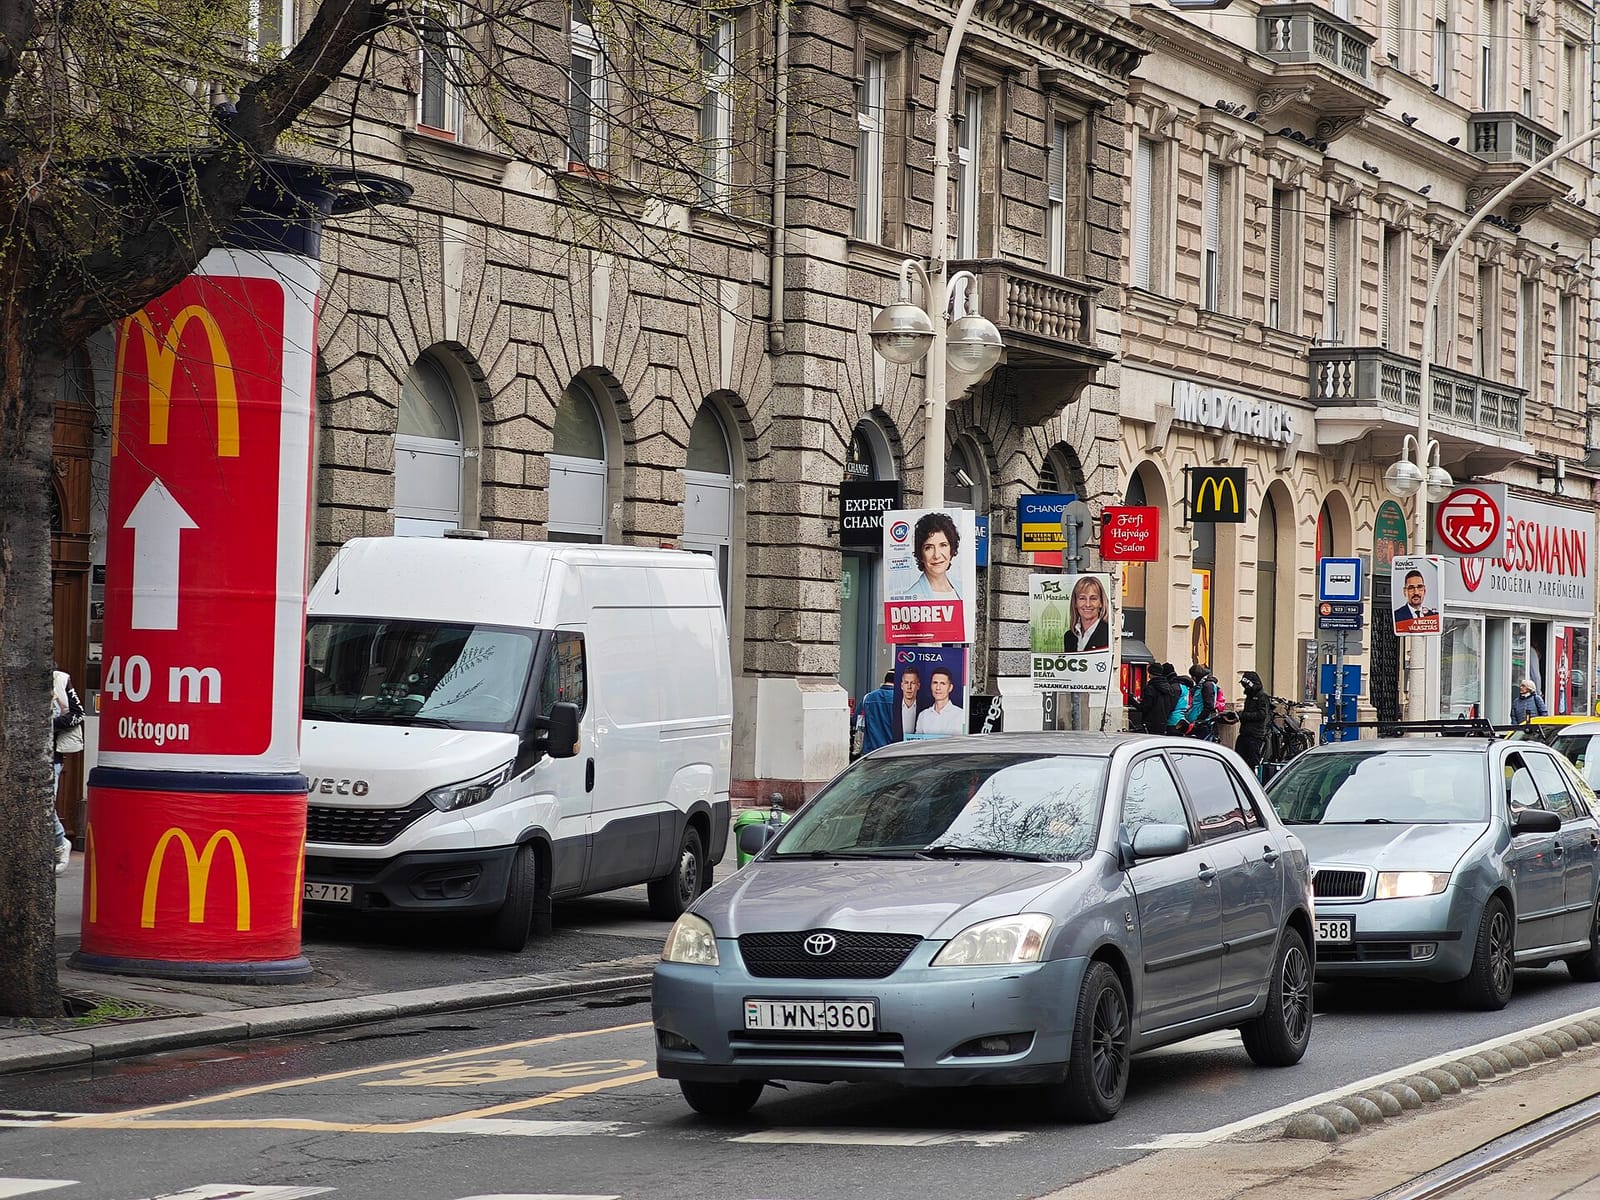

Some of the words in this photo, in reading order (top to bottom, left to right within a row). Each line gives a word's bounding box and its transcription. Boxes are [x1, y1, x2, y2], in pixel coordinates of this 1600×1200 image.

[1173, 380, 1295, 444] McDonald's
[845, 498, 894, 512] EXPERT
[1117, 514, 1143, 527] Férfi
[1111, 528, 1150, 541] Hajvágó
[1113, 542, 1145, 554] Szalon
[1490, 574, 1532, 593] DROGÉRIA
[1538, 580, 1585, 600] PARFÜMÉRIA
[1046, 593, 1070, 601] Hazánk
[890, 605, 954, 623] DOBREV
[891, 623, 911, 631] KLÁRA
[918, 653, 943, 662] TISZA
[1033, 656, 1088, 672] EDŐCS
[105, 655, 152, 702] 40
[168, 666, 222, 704] m
[118, 717, 189, 746] Oktogon
[306, 777, 369, 797] VECO
[749, 1016, 758, 1026] H
[770, 1004, 870, 1028] IWN-360
